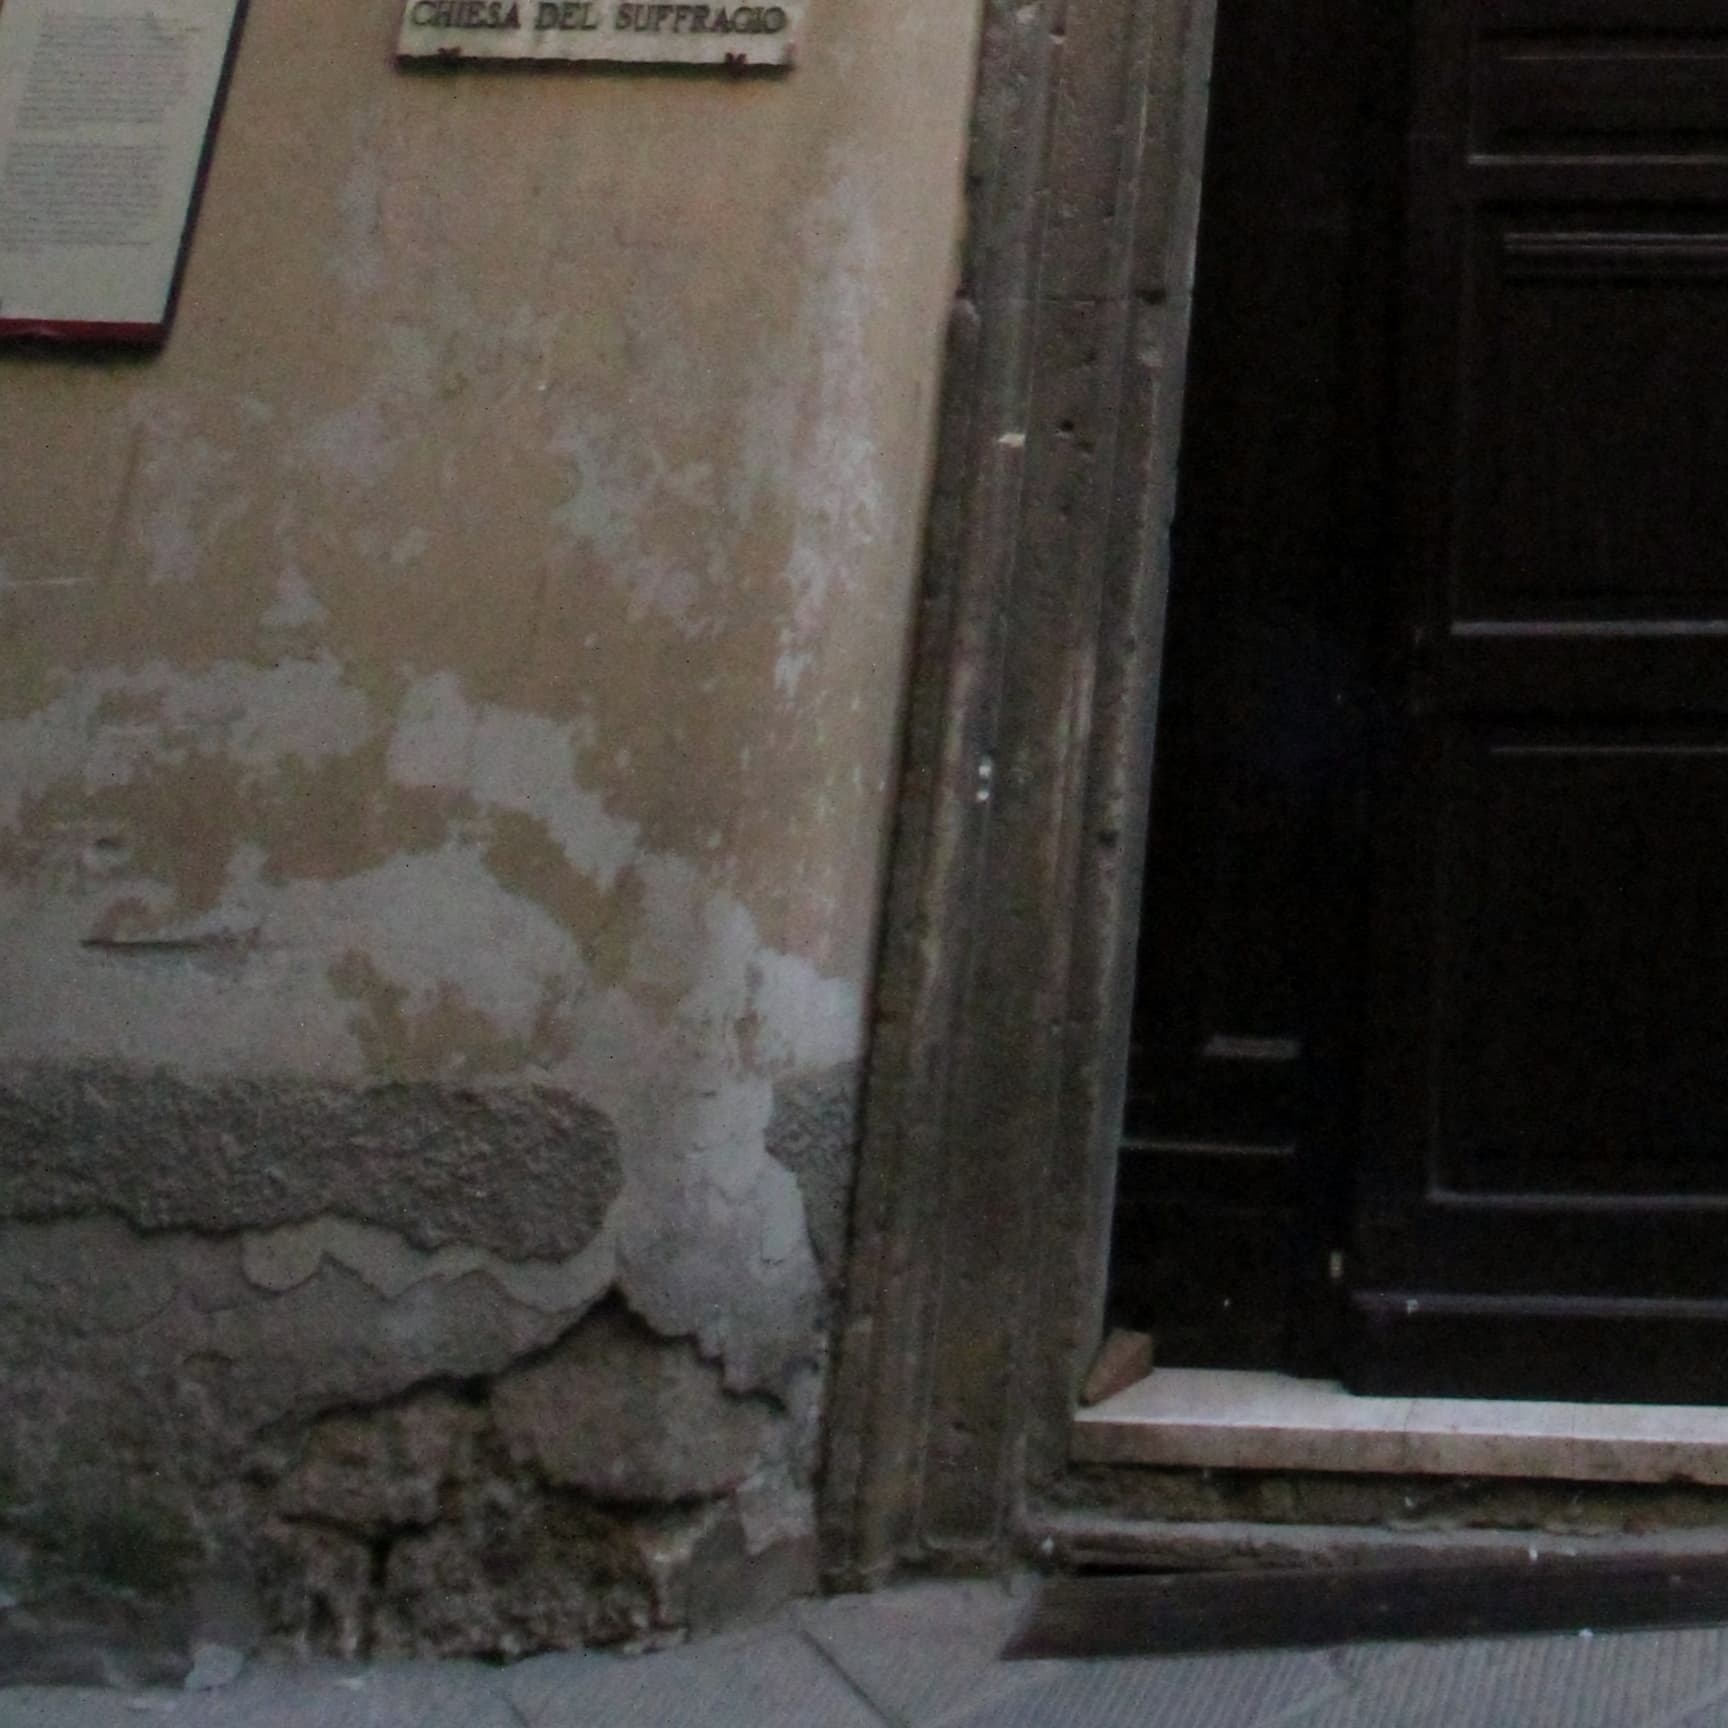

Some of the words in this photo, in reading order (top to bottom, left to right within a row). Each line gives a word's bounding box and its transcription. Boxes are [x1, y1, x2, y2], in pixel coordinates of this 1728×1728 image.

[408, 0, 521, 30] CHIESA
[534, 2, 598, 31] DEL
[615, 3, 788, 34] SUFFRAGIO
